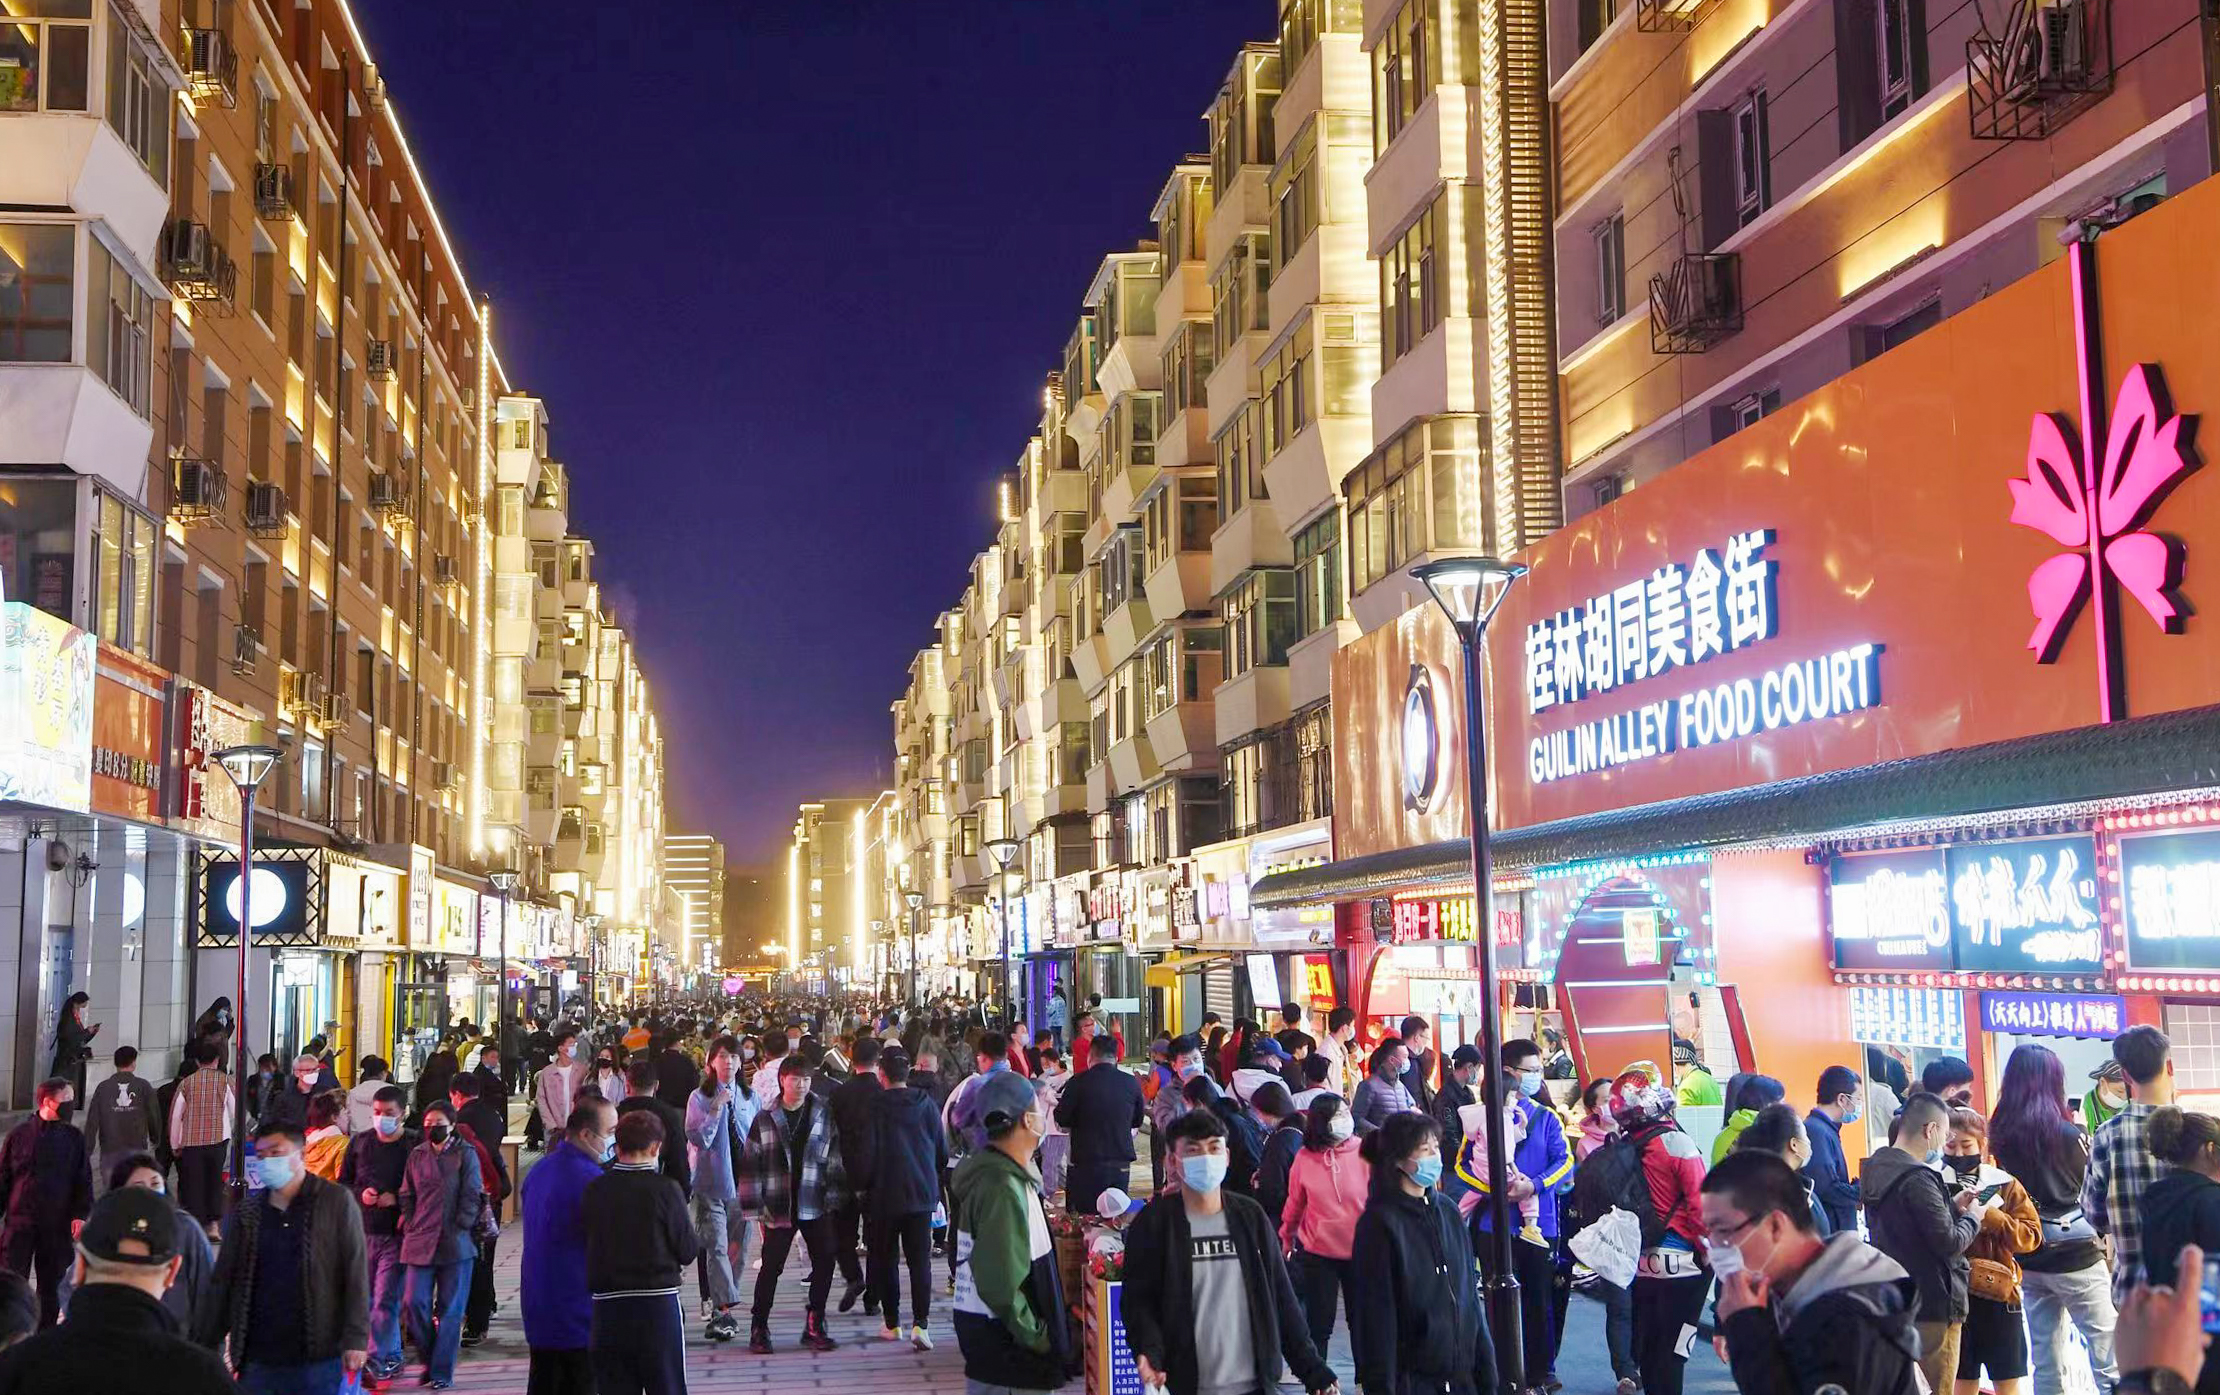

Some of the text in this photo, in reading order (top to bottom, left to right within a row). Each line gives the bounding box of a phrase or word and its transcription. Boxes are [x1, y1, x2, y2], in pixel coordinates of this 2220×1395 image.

[1526, 529, 1768, 715] 桂林胡同美食街
[1679, 678, 1756, 749] FOOD
[1761, 642, 1874, 730] COURT
